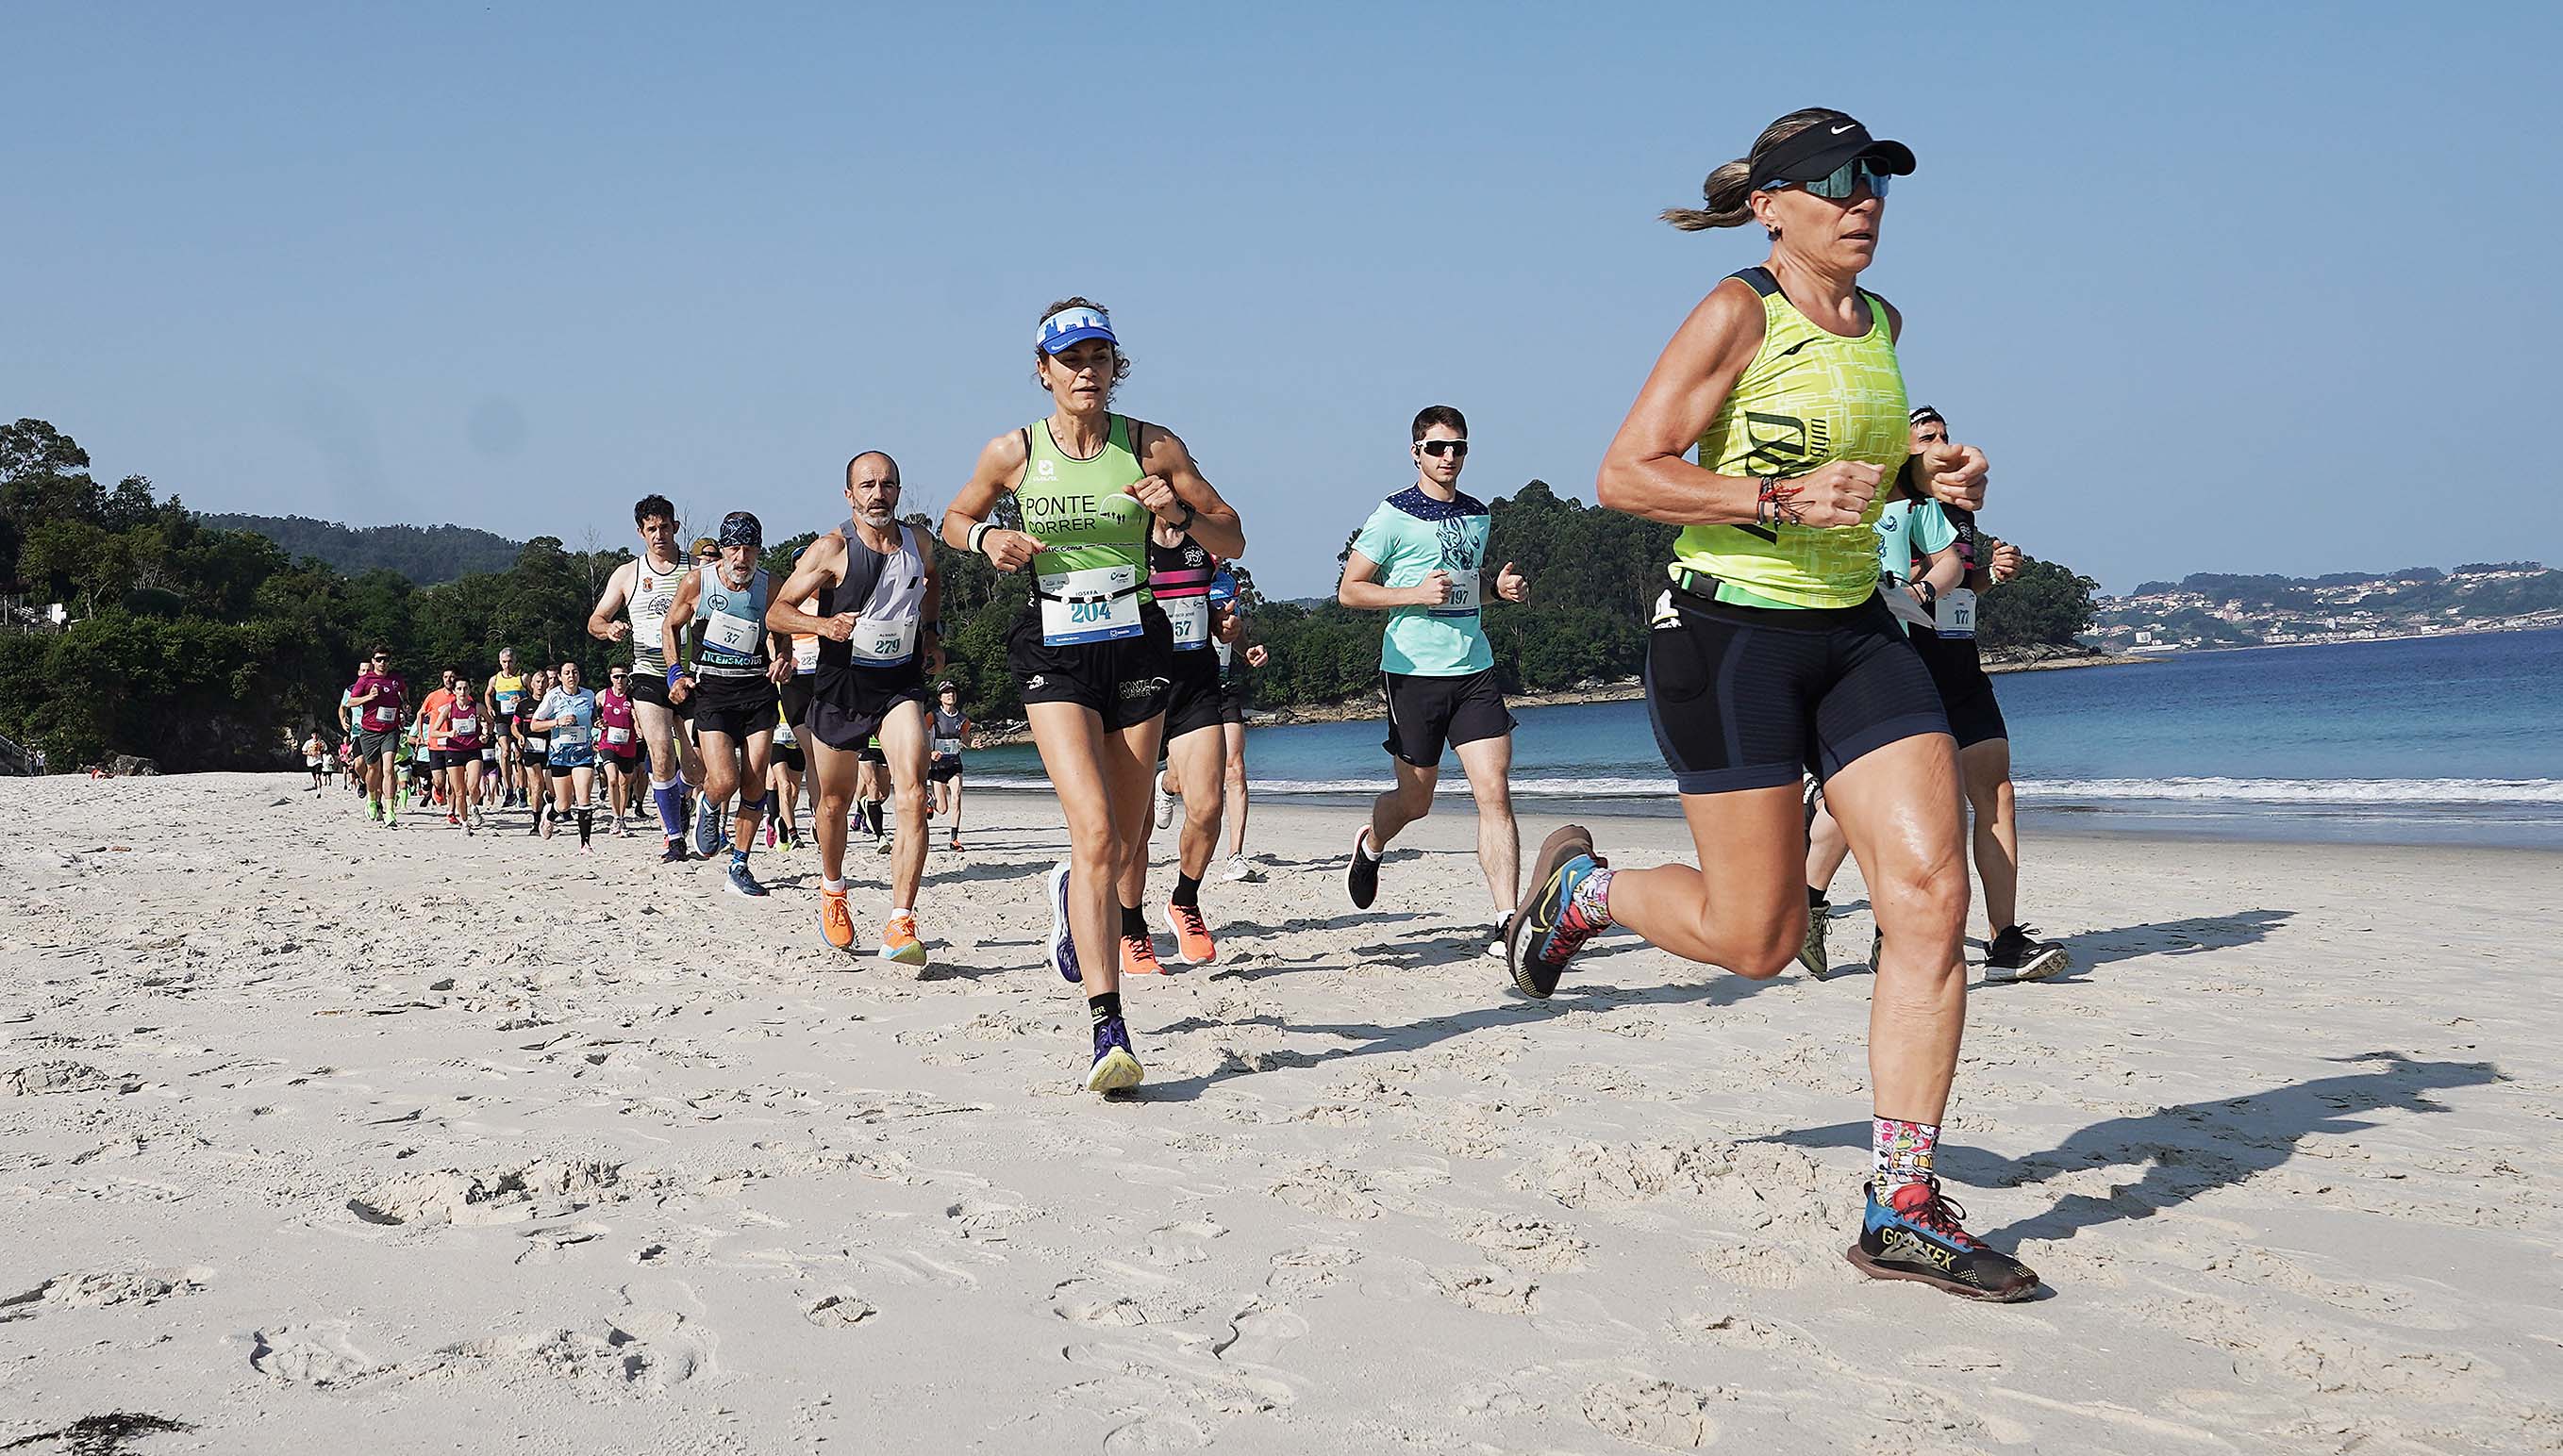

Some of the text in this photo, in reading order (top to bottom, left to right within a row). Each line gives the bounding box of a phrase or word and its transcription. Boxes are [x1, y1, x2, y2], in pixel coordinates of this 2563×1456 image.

[1026, 495, 1097, 516] PONTE
[1028, 518, 1096, 535] CORRER
[1450, 590, 1469, 604] 197
[1072, 601, 1111, 622] 204
[724, 632, 741, 644] 37
[874, 638, 901, 654] 279
[1119, 679, 1150, 690] PONTE
[1882, 1228, 1957, 1271] GOTEX
